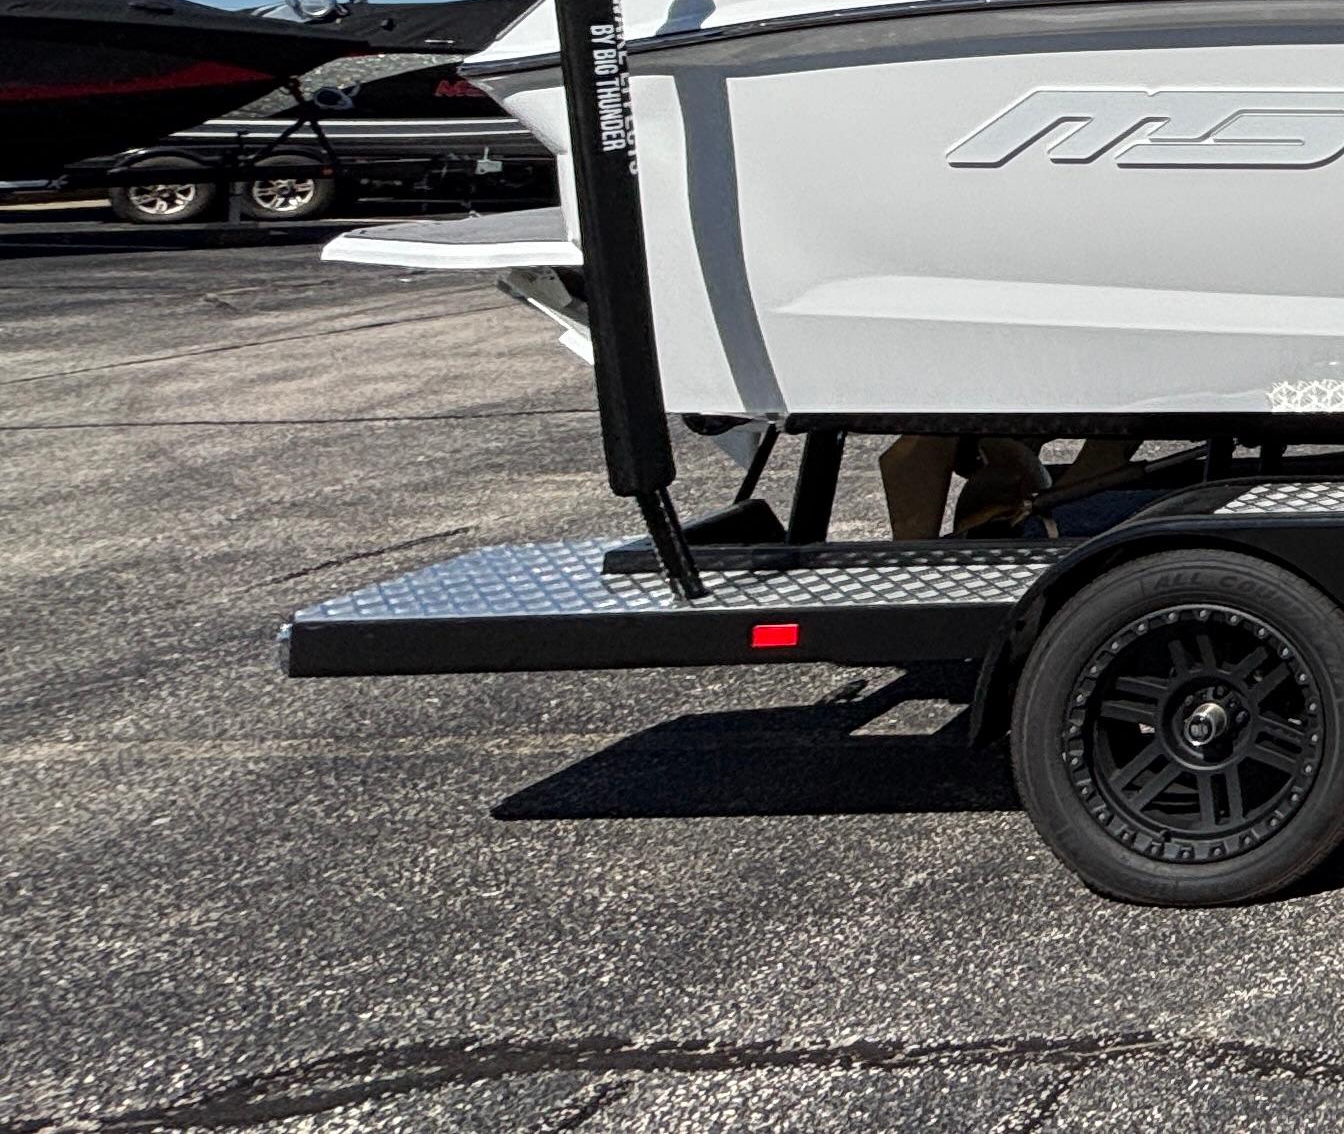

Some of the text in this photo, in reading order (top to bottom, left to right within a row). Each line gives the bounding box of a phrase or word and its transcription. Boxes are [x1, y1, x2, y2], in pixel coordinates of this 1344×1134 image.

[590, 24, 617, 45] BY
[593, 49, 619, 75] BIG
[596, 77, 627, 152] THUNDER
